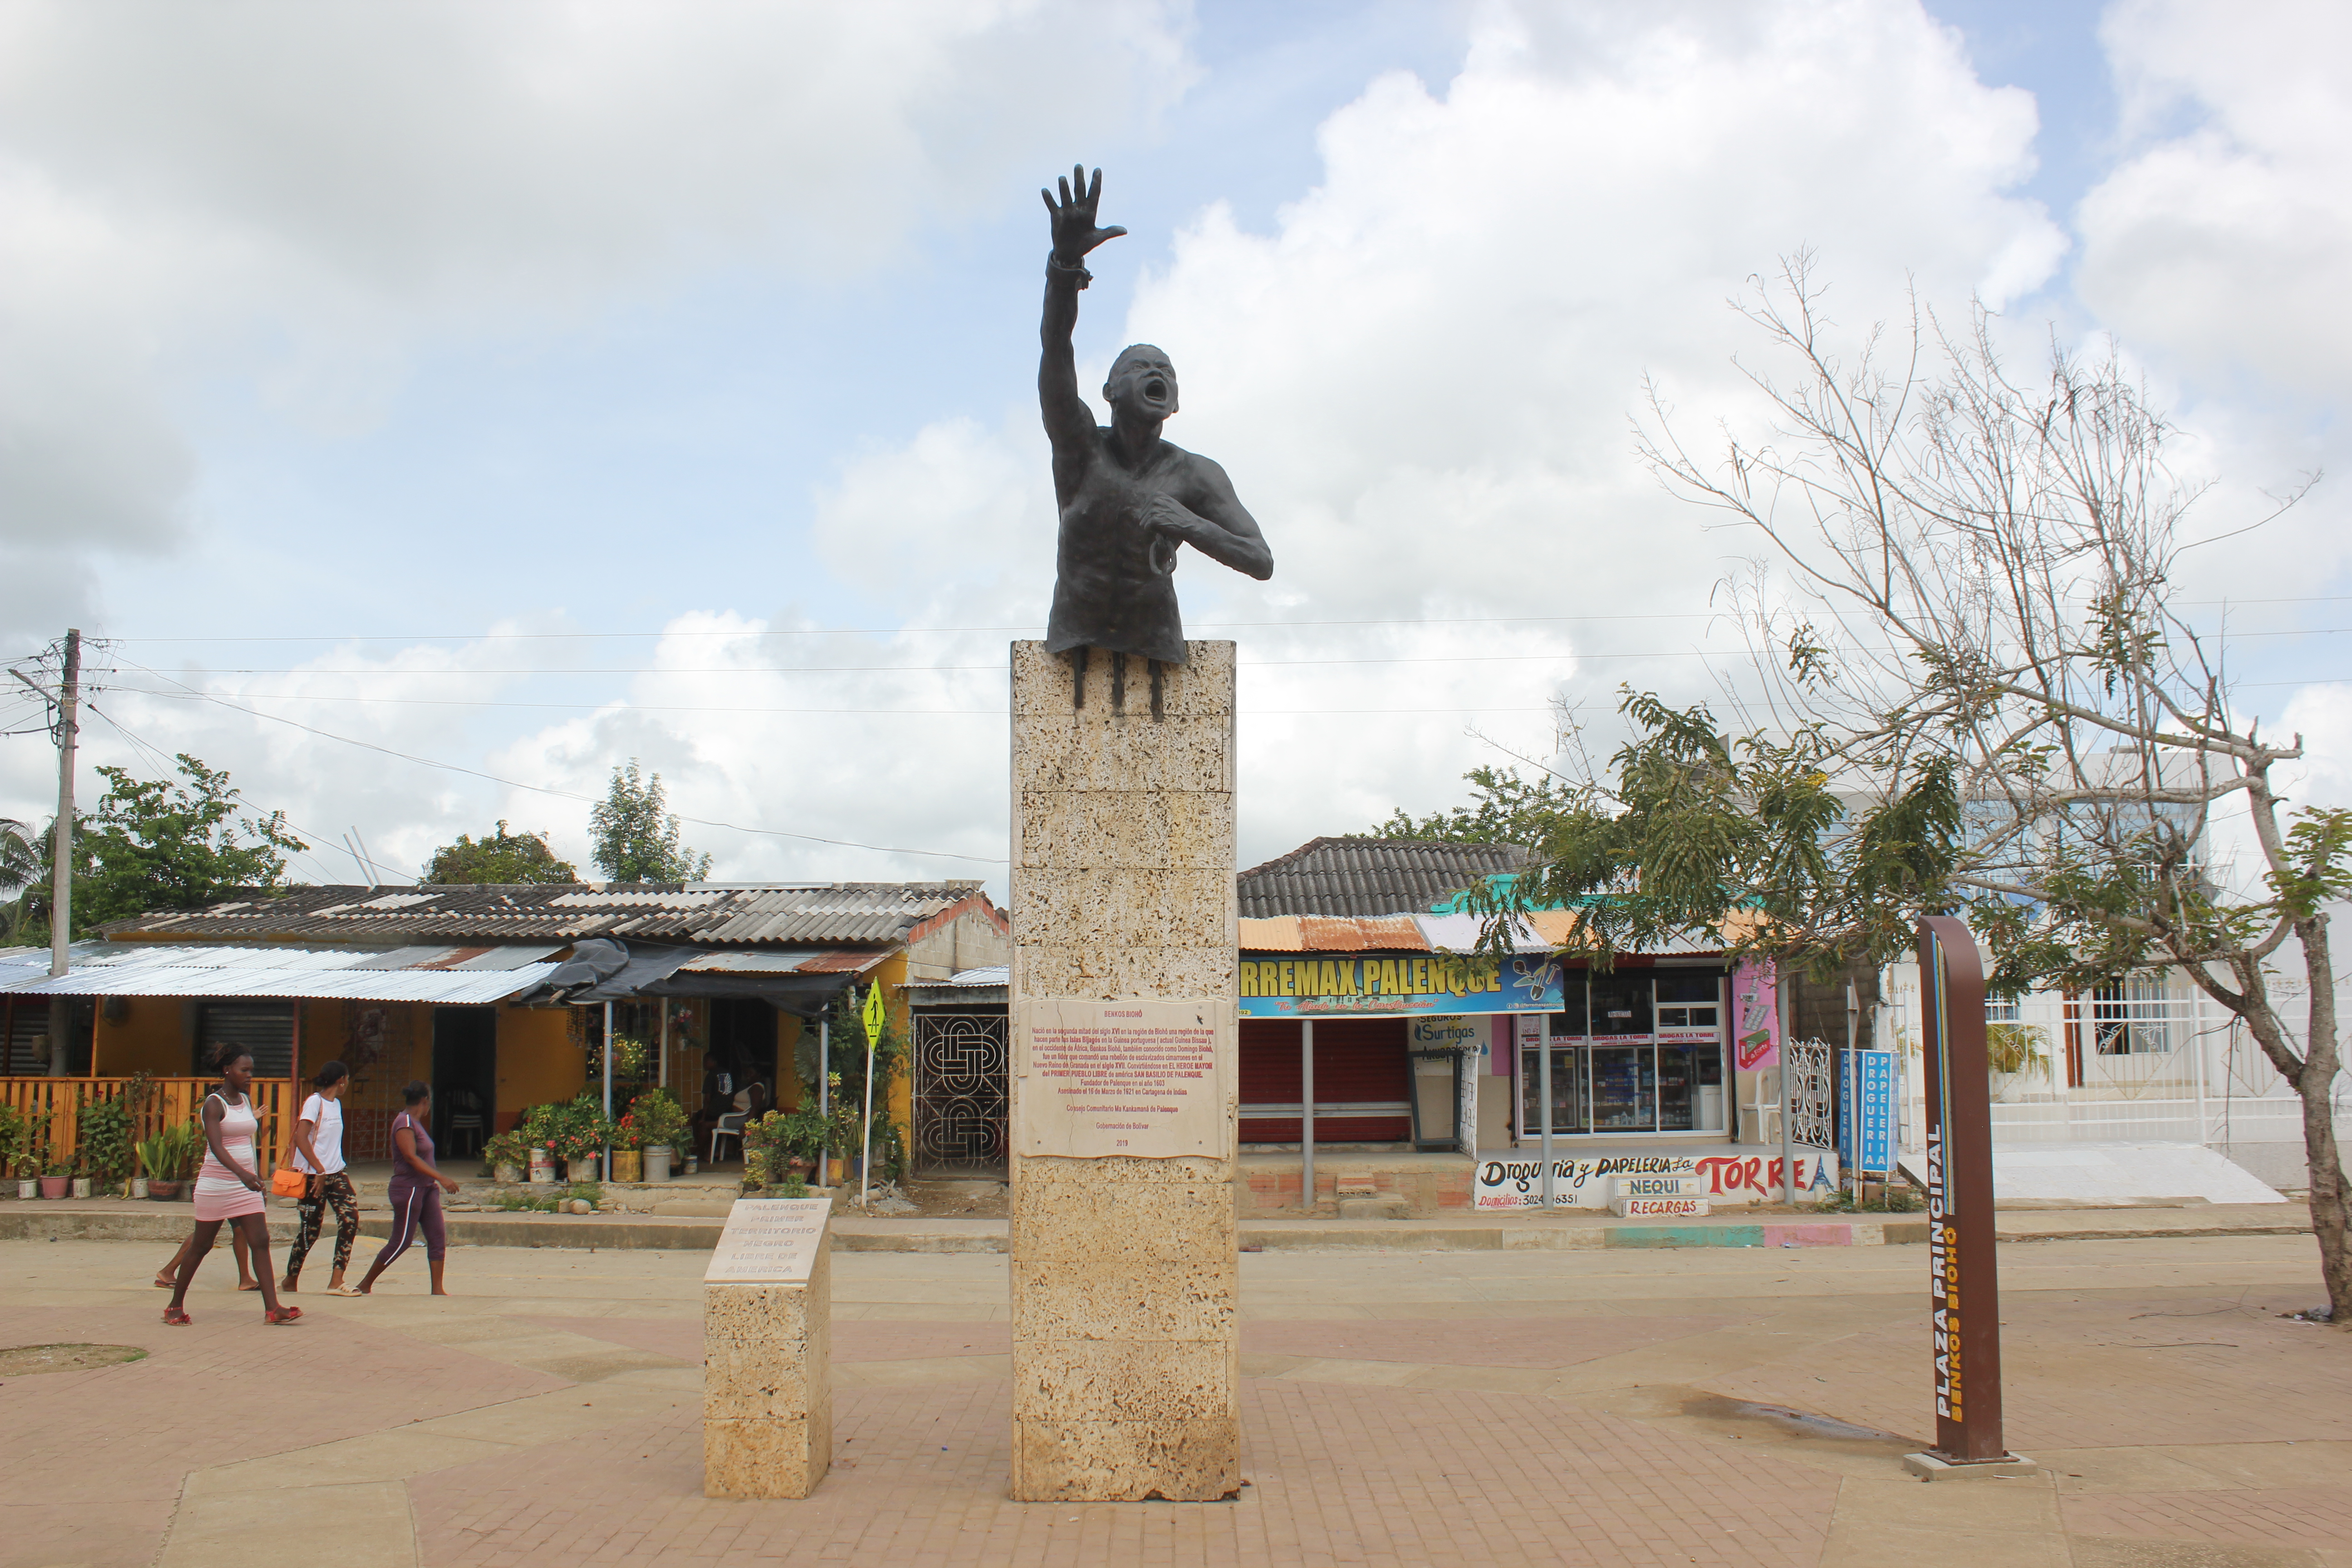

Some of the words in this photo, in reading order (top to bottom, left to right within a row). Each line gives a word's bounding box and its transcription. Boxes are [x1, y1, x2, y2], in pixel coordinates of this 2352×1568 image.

[1126, 1009, 1142, 1017] BIOHÓ
[1352, 1001, 1364, 1011] la
[1058, 1027, 1078, 1036] segunda
[1100, 1028, 1111, 1036] siglo
[1132, 1028, 1147, 1036] región
[1178, 1028, 1193, 1037] región
[1422, 1024, 1475, 1044] Surtigas
[1049, 1036, 1061, 1044] parte
[1130, 1037, 1156, 1045] portuguesa
[1074, 1044, 1089, 1053] África,
[1177, 1045, 1198, 1054] Domingo
[1102, 1062, 1114, 1071] siglo
[1109, 1079, 1131, 1088] Palenque
[1142, 1088, 1166, 1097] Cartagena
[1156, 1105, 1179, 1114] Palenque
[1841, 1054, 1850, 1161] DROGUERIA
[1865, 1056, 1877, 1165] DROGUERIA
[1877, 1056, 1888, 1165] PAPELERIA
[1480, 1159, 1574, 1192] Droguria
[1573, 1164, 1594, 1188] y
[1595, 1157, 1671, 1178] PAPELERIA
[1695, 1155, 1807, 1197] TORRE
[1630, 1179, 1680, 1195] NEQUI
[1523, 1194, 1578, 1205] 30246351
[1631, 1200, 1696, 1215] RECARGAS
[1928, 1124, 1946, 1299] PRINCIPAL
[1943, 1227, 1960, 1309] BIOHÓ
[1934, 1308, 1950, 1418] PLAZA
[1948, 1317, 1963, 1423] BENKOS
